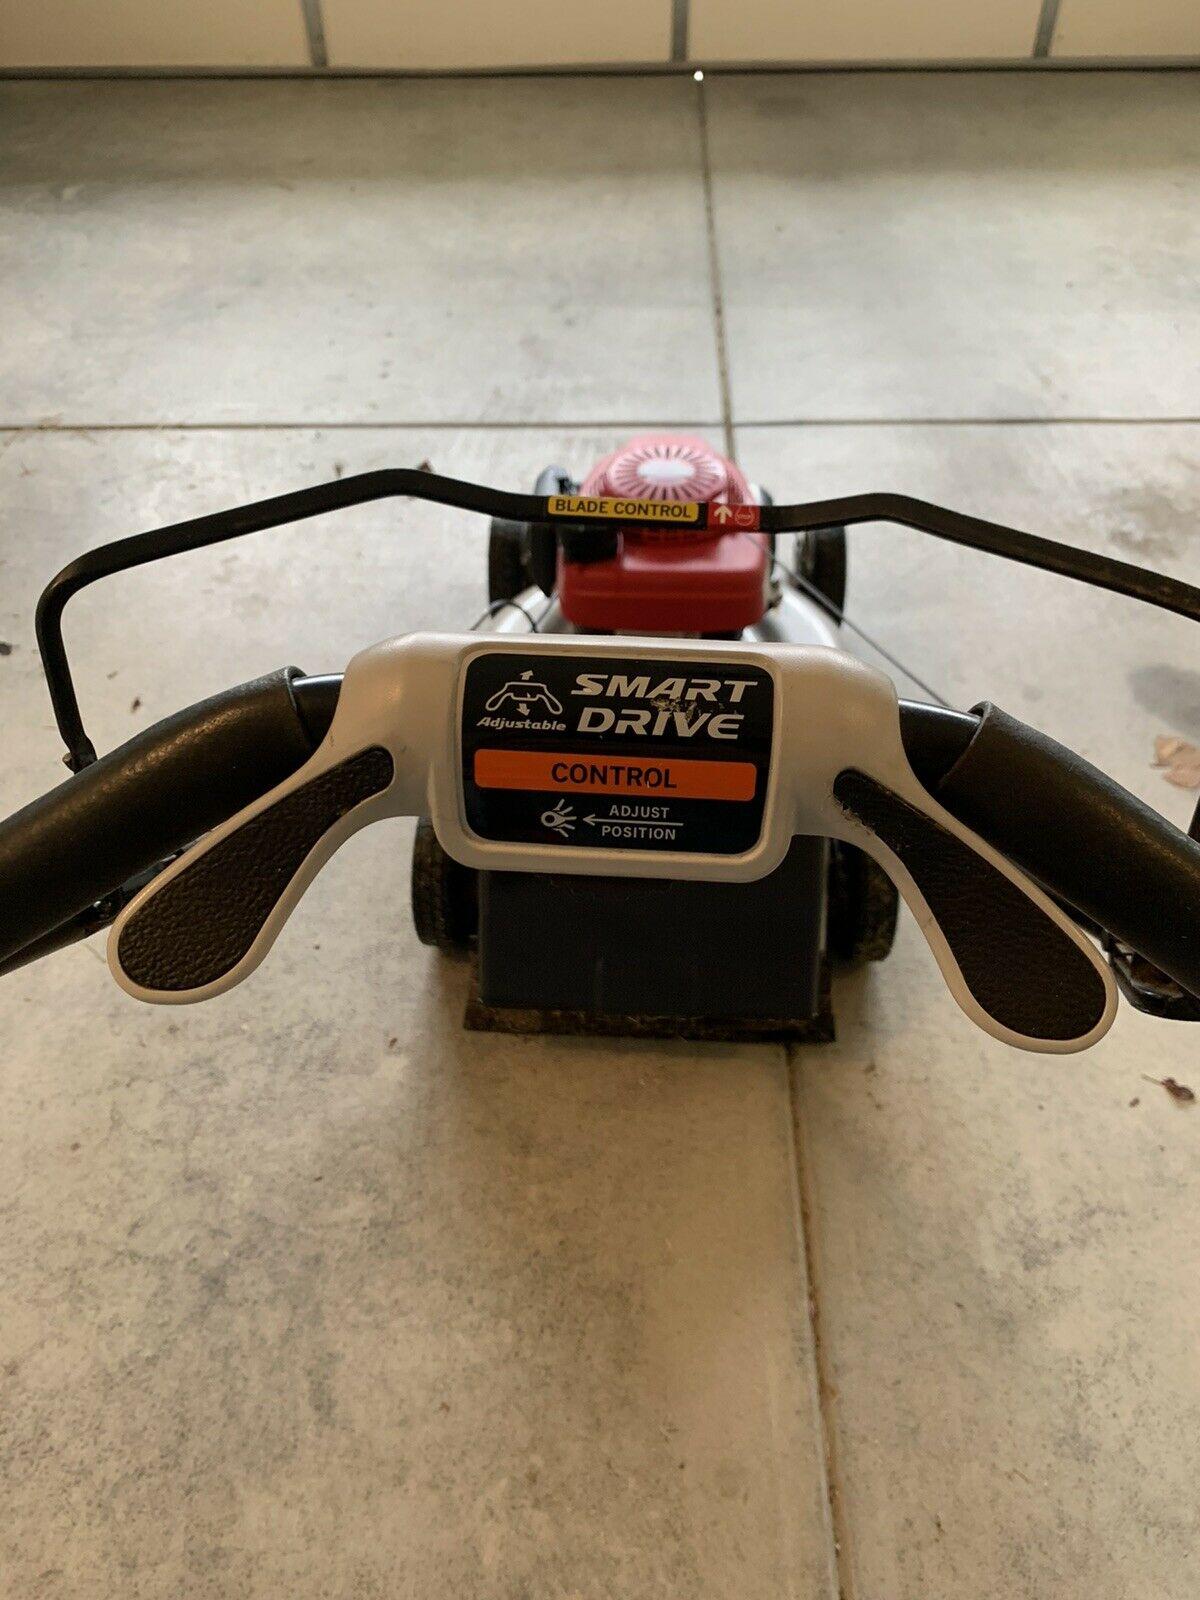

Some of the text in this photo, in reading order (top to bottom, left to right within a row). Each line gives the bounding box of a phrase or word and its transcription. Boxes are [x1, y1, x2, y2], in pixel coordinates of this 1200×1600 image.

[555, 499, 691, 518] BLADE CONTROL
[571, 673, 758, 702] SMART
[477, 716, 567, 732] Adjustable
[577, 707, 744, 740] DRIVE
[551, 763, 677, 788] CONTROL
[609, 804, 670, 819] ADJUST
[601, 825, 676, 841] POSITION
